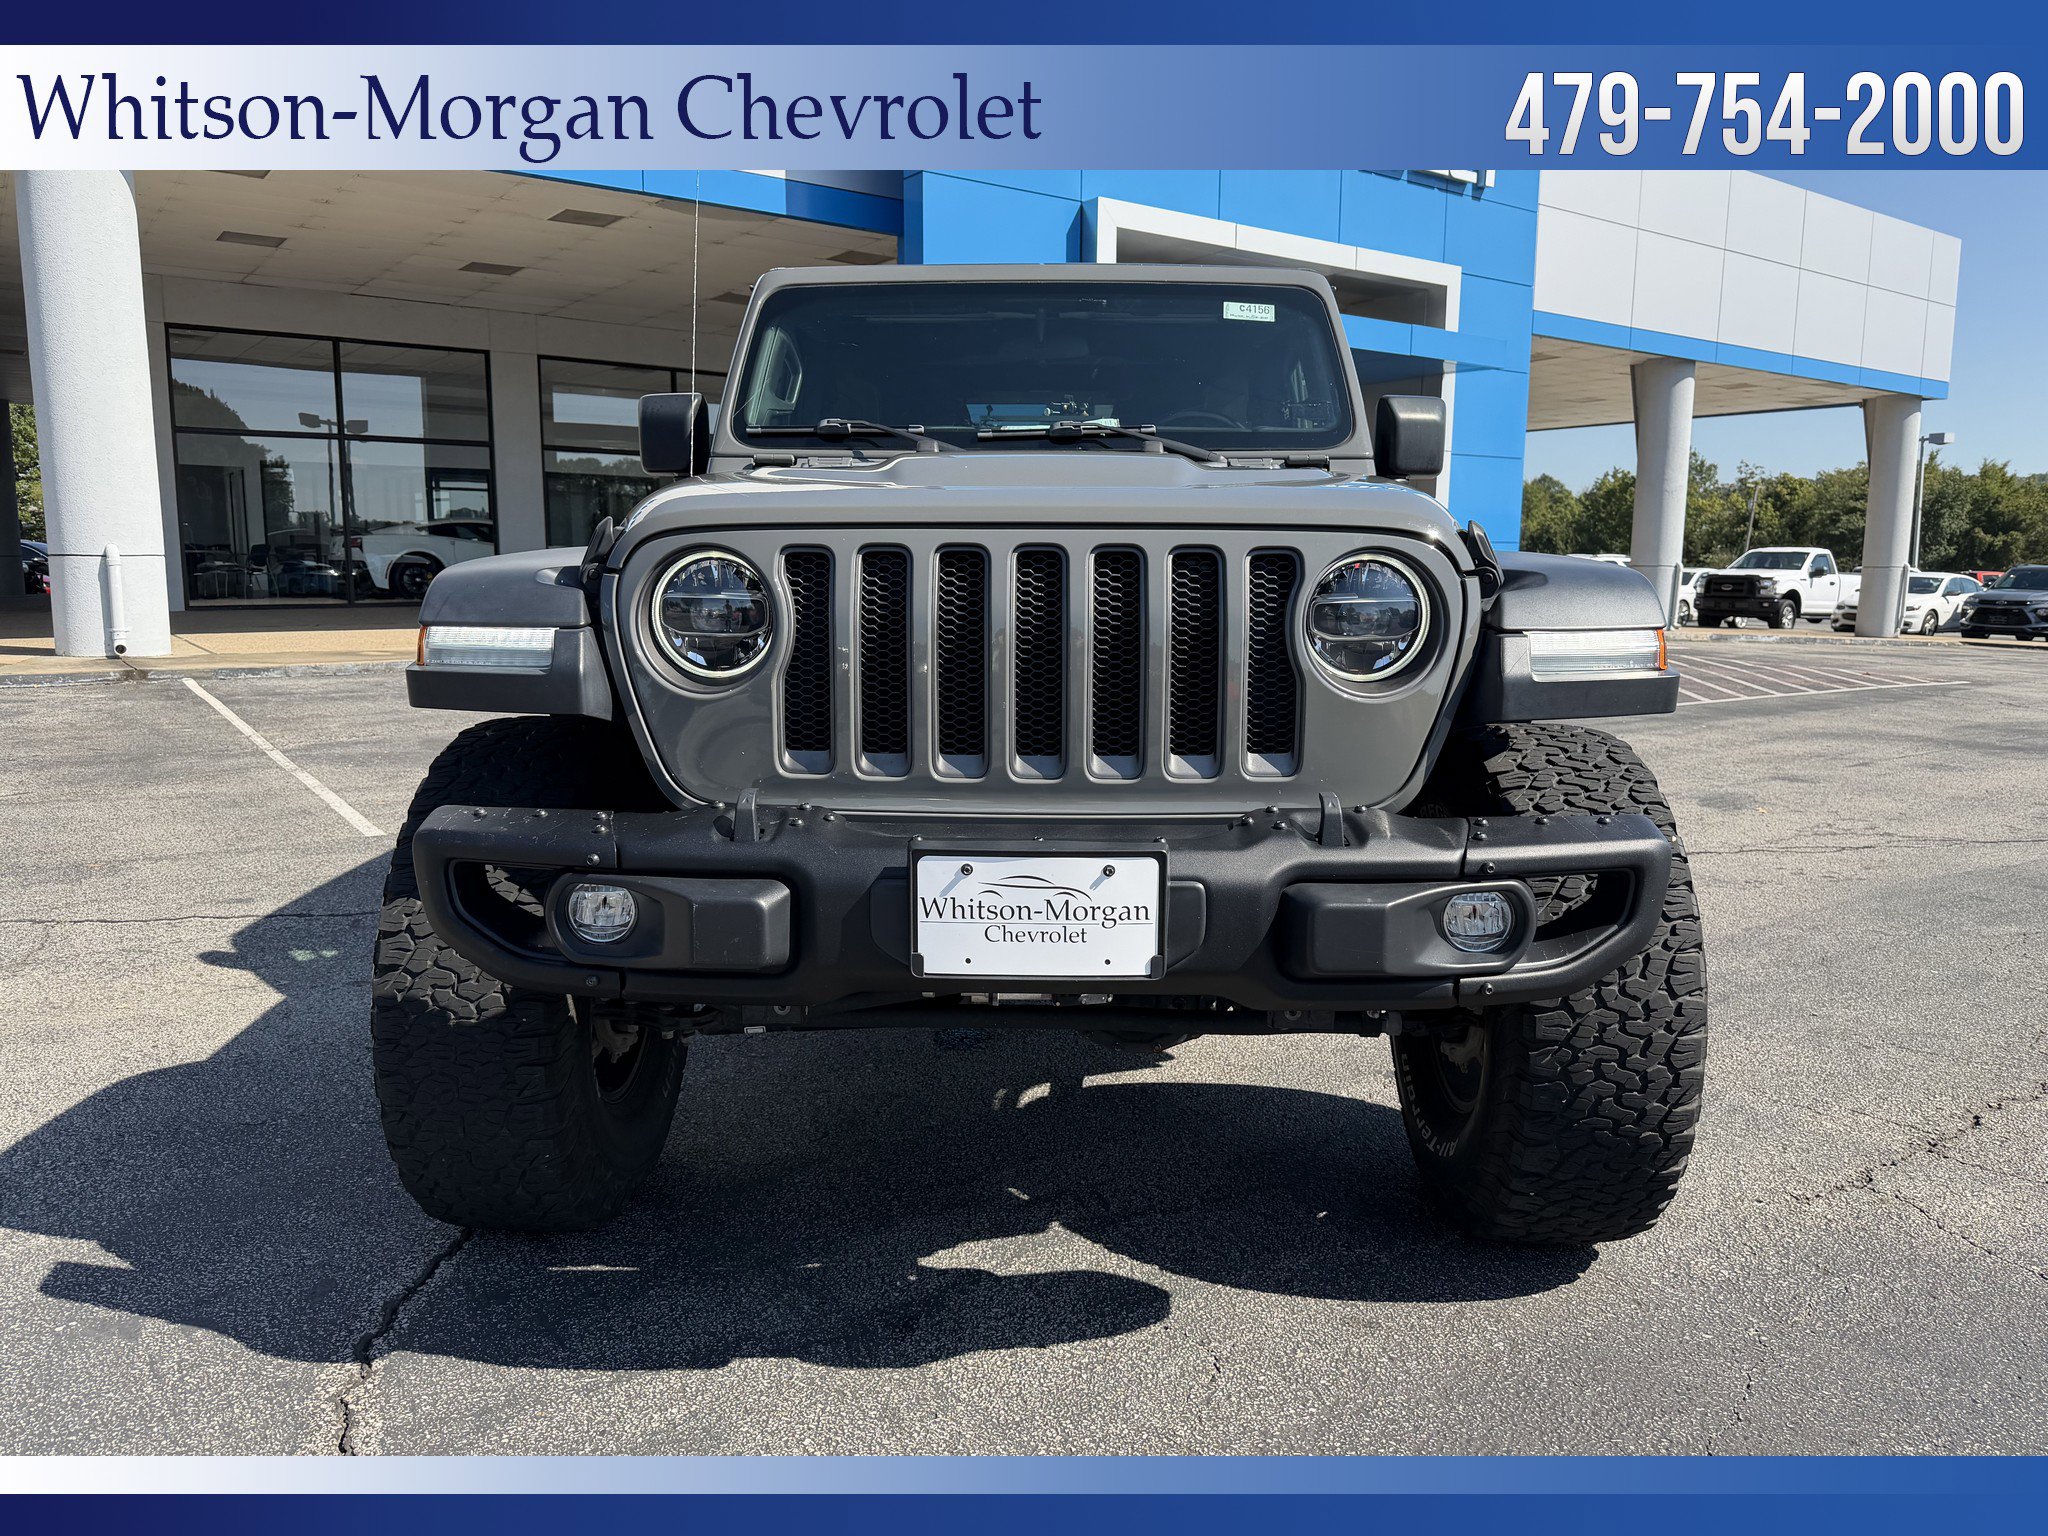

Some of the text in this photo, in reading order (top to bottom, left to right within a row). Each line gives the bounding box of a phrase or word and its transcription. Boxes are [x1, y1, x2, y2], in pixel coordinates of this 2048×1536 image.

[1239, 304, 1271, 315] C4156
[919, 897, 1151, 929] Whitson-Morgan
[984, 924, 1088, 944] Chevrolet
